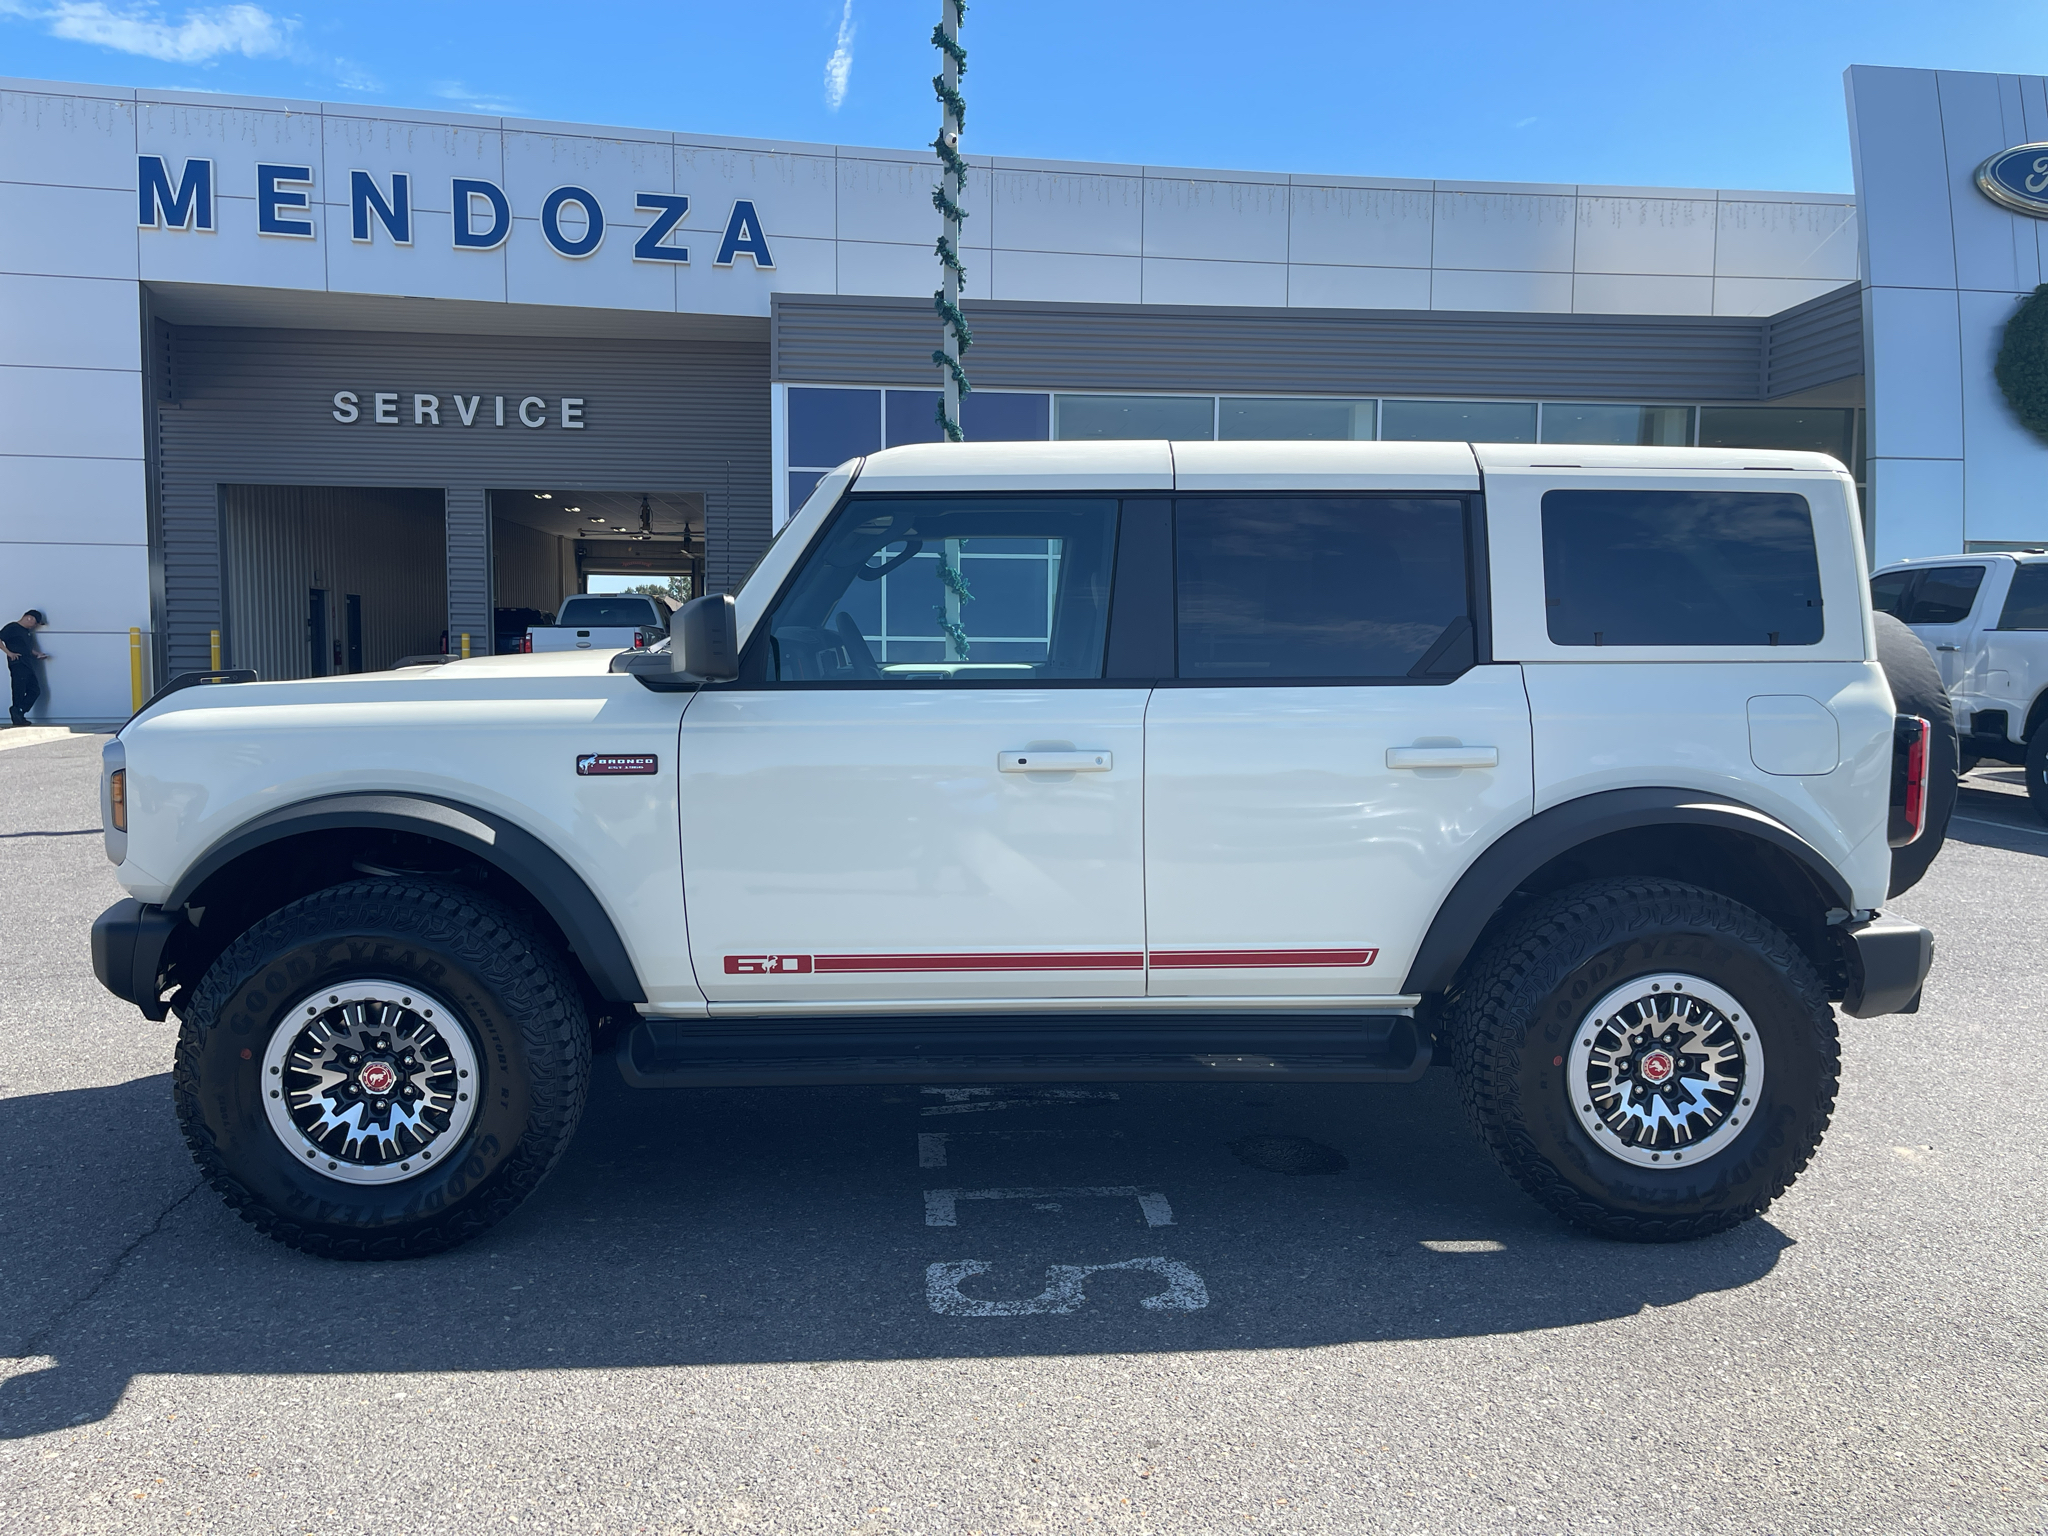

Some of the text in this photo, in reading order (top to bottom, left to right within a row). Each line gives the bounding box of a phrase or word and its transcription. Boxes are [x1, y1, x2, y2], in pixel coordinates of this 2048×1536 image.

[136, 154, 777, 269] MENDOZA
[332, 391, 588, 429] SERVICE
[230, 938, 448, 1036] GOODYEAR
[465, 993, 508, 1074] TERRITORY
[1544, 936, 1734, 1043] GOODYEAR
